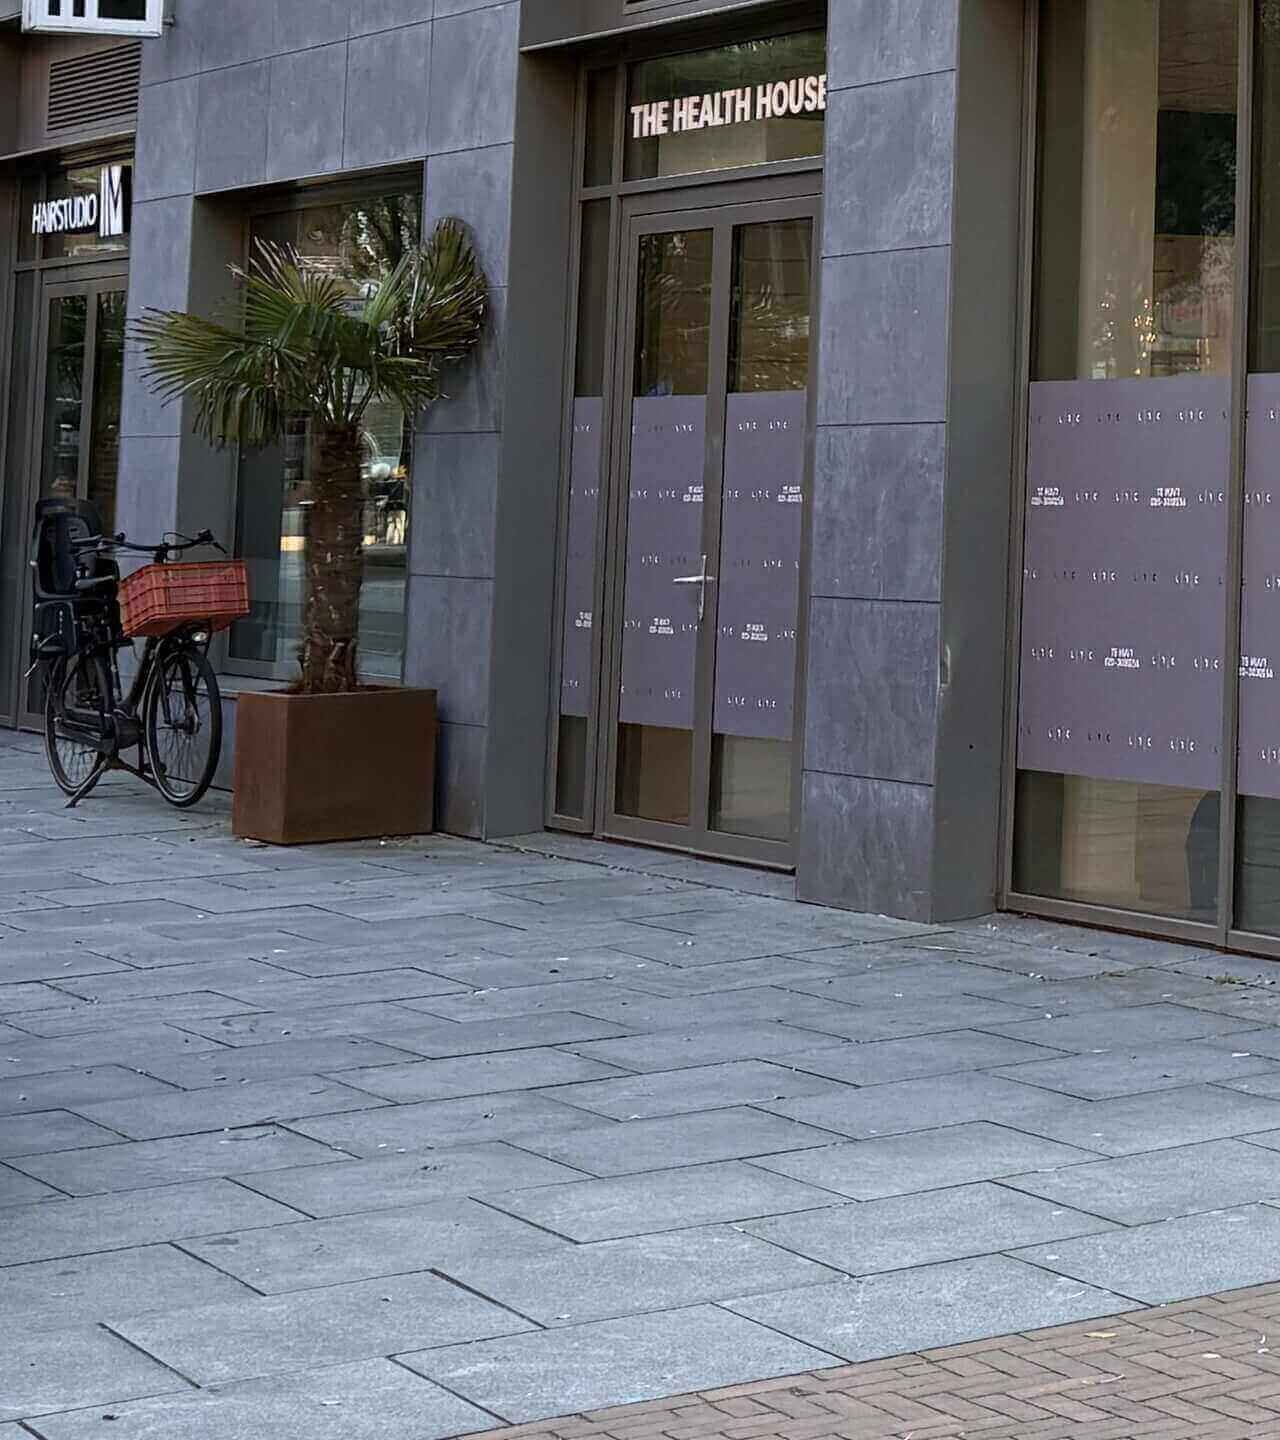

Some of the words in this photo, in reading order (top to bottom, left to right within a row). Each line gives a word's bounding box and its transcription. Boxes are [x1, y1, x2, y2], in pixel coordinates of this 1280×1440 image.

[630, 100, 669, 139] THE
[672, 86, 752, 133] HEALTH
[755, 73, 828, 120] HOUSE
[31, 192, 98, 235] HAIRSTUDIO
